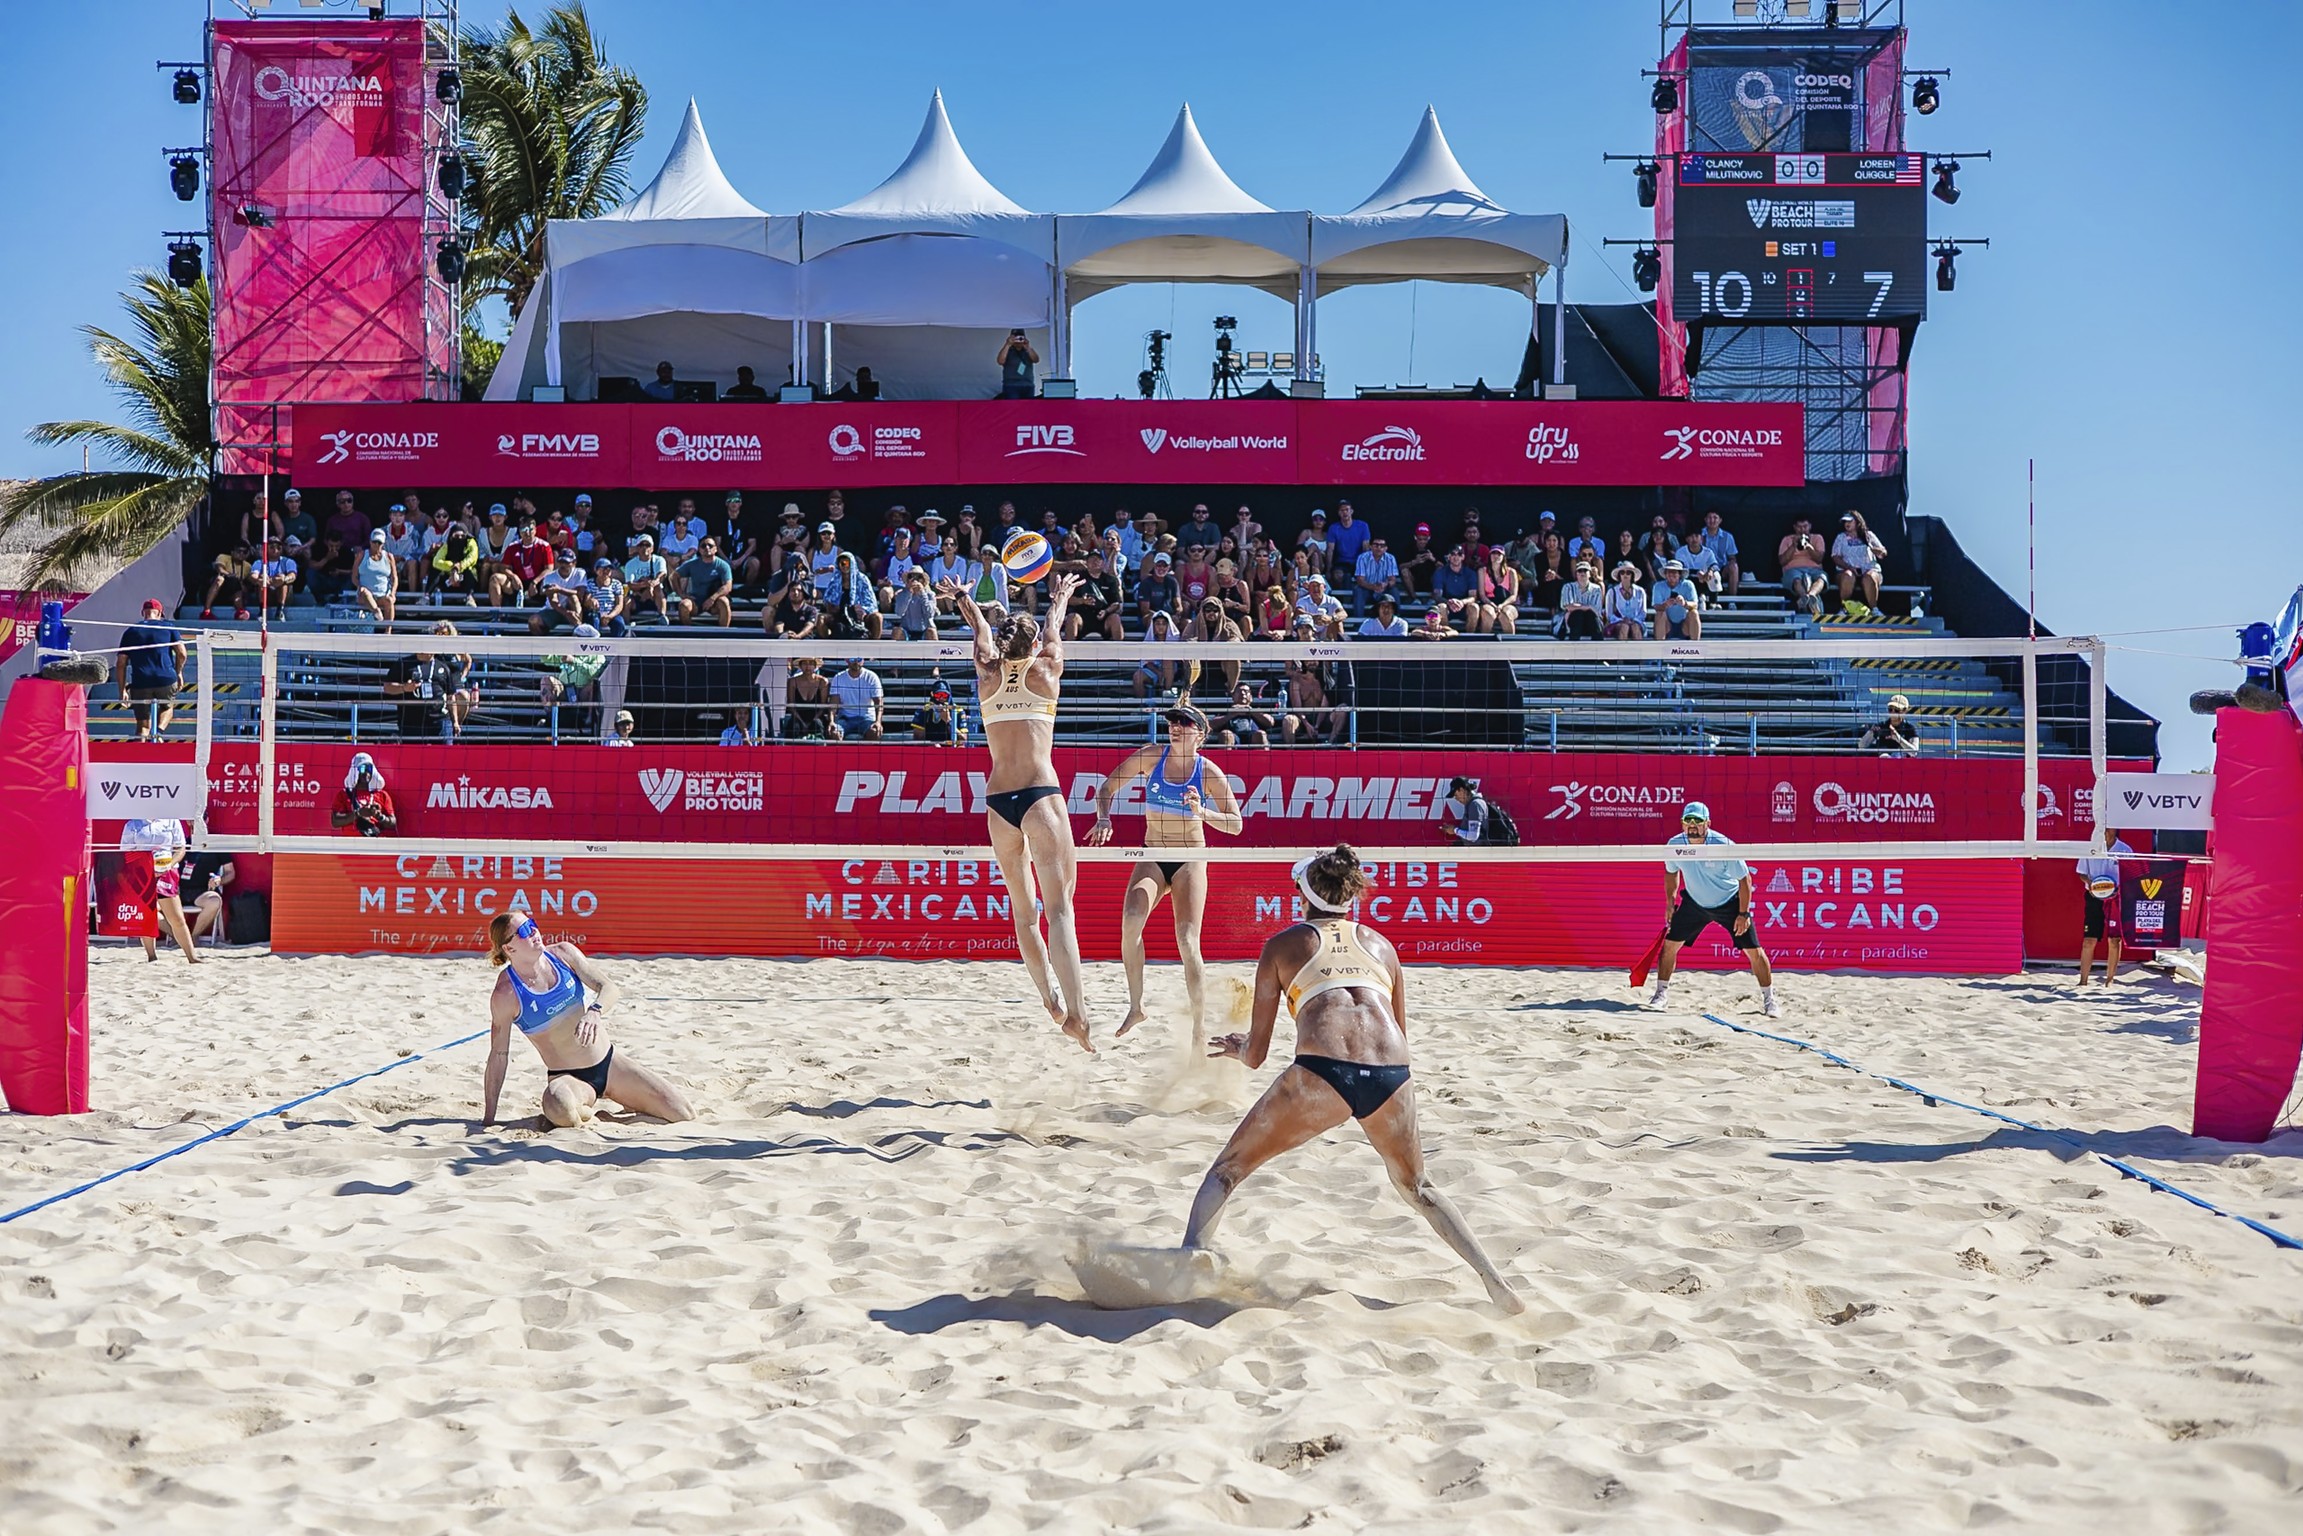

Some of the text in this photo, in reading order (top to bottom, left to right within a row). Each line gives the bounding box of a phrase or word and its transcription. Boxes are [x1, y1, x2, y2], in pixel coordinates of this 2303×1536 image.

[254, 65, 383, 101] QUINTANA
[1794, 74, 1852, 89] CODEQ
[289, 91, 335, 107] ROO
[1705, 160, 1743, 169] CLANCY
[1781, 160, 1795, 178] 0
[1806, 160, 1819, 178] 0
[1859, 160, 1895, 169] LOREEN
[1705, 170, 1763, 179] MILUTINOVIC
[1854, 170, 1895, 179] QUIGGLE
[1771, 206, 1813, 218] BEACH
[1771, 218, 1813, 228] PRO TOUR
[1782, 243, 1817, 255] SET 1
[1762, 272, 1776, 285] 10
[1828, 272, 1836, 285] 7
[1692, 271, 1752, 318] 10
[1863, 271, 1893, 318] 7
[355, 432, 439, 448] CONADE
[656, 426, 761, 456] QUINTANA
[875, 428, 921, 440] CODEQ
[1017, 425, 1075, 446] FIVB
[1528, 422, 1569, 449] dry
[1699, 429, 1782, 445] CONADE
[522, 434, 599, 451] FMVB
[1170, 435, 1287, 452] Volleyball World
[685, 448, 722, 461] ROO
[1341, 443, 1425, 461] Electrolit
[1525, 443, 1554, 464] up
[1007, 673, 1019, 684] 2
[1005, 685, 1019, 693] AUS
[125, 784, 181, 799] VBTV
[207, 779, 321, 794] MEXIANO
[685, 778, 763, 797] BEACH
[1151, 783, 1160, 793] 2
[1589, 785, 1685, 804] CONADE
[1813, 781, 1935, 816] QUINTANA
[2147, 794, 2202, 809] VBTV
[283, 799, 316, 809] paradise
[685, 797, 763, 811] PRO TOUR
[1846, 808, 1889, 823] ROO
[118, 903, 138, 915] dry
[359, 886, 598, 917] MEXICANO
[806, 893, 1043, 921] MEXICAN
[2136, 903, 2165, 911] BEACH
[117, 911, 132, 922] up
[1255, 896, 1494, 924] MEICANO
[370, 929, 400, 944] The
[816, 935, 847, 951] The
[853, 931, 959, 956] signature
[1332, 932, 1341, 943] 1
[1331, 946, 1348, 954] AUS
[1416, 936, 1482, 954] paradise
[1710, 943, 1741, 958] The
[1861, 943, 1929, 962] paradise
[1335, 967, 1370, 975] VBTV
[530, 1000, 538, 1013] 1
